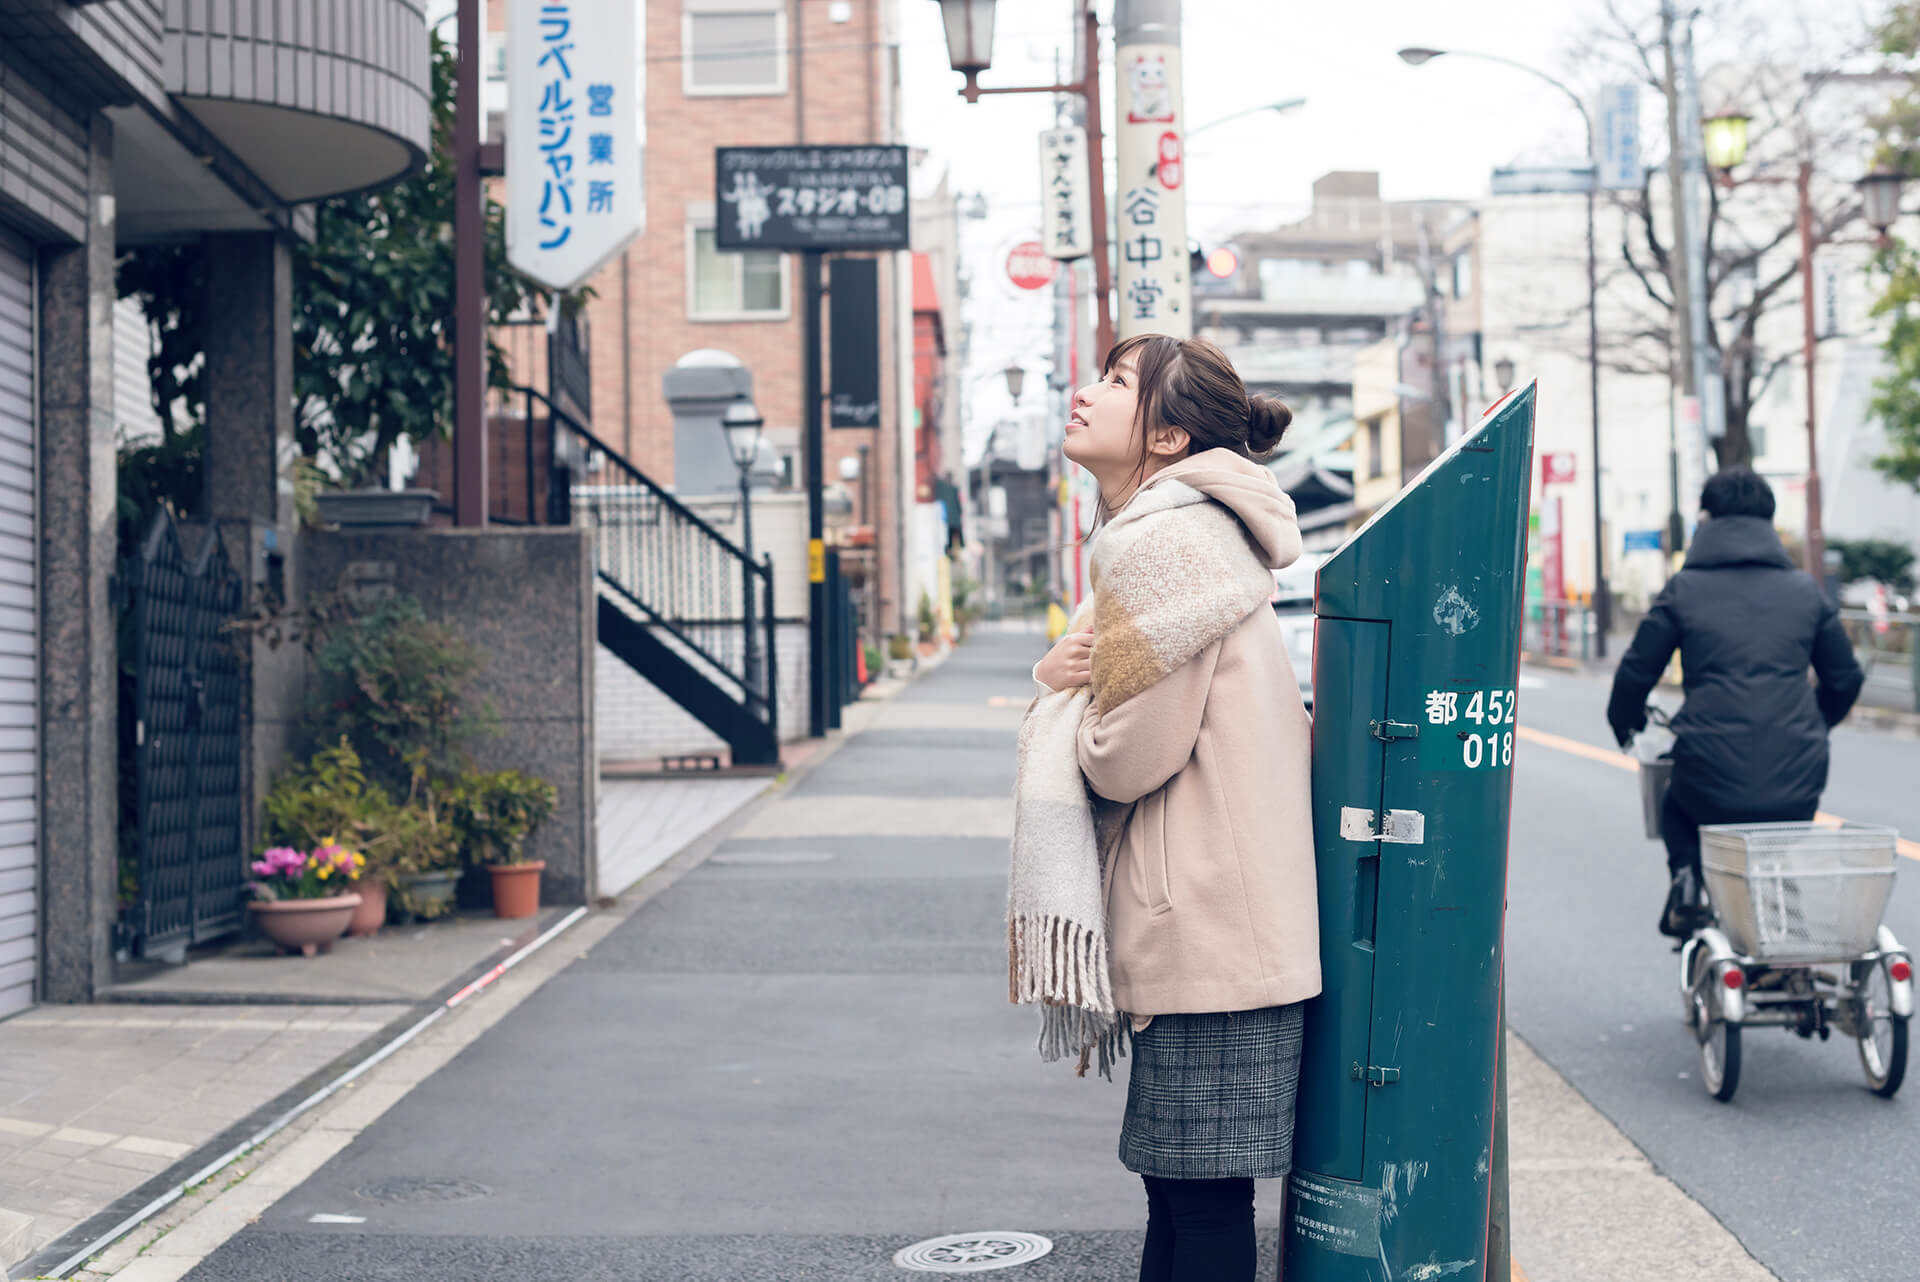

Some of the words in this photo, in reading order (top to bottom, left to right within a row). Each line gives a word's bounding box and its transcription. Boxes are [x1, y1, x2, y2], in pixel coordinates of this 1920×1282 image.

[587, 84, 614, 214] 営業所
[1125, 186, 1163, 320] 谷中堂
[1424, 689, 1458, 725] 都
[1464, 689, 1515, 725] 452
[1463, 731, 1513, 768] 018
